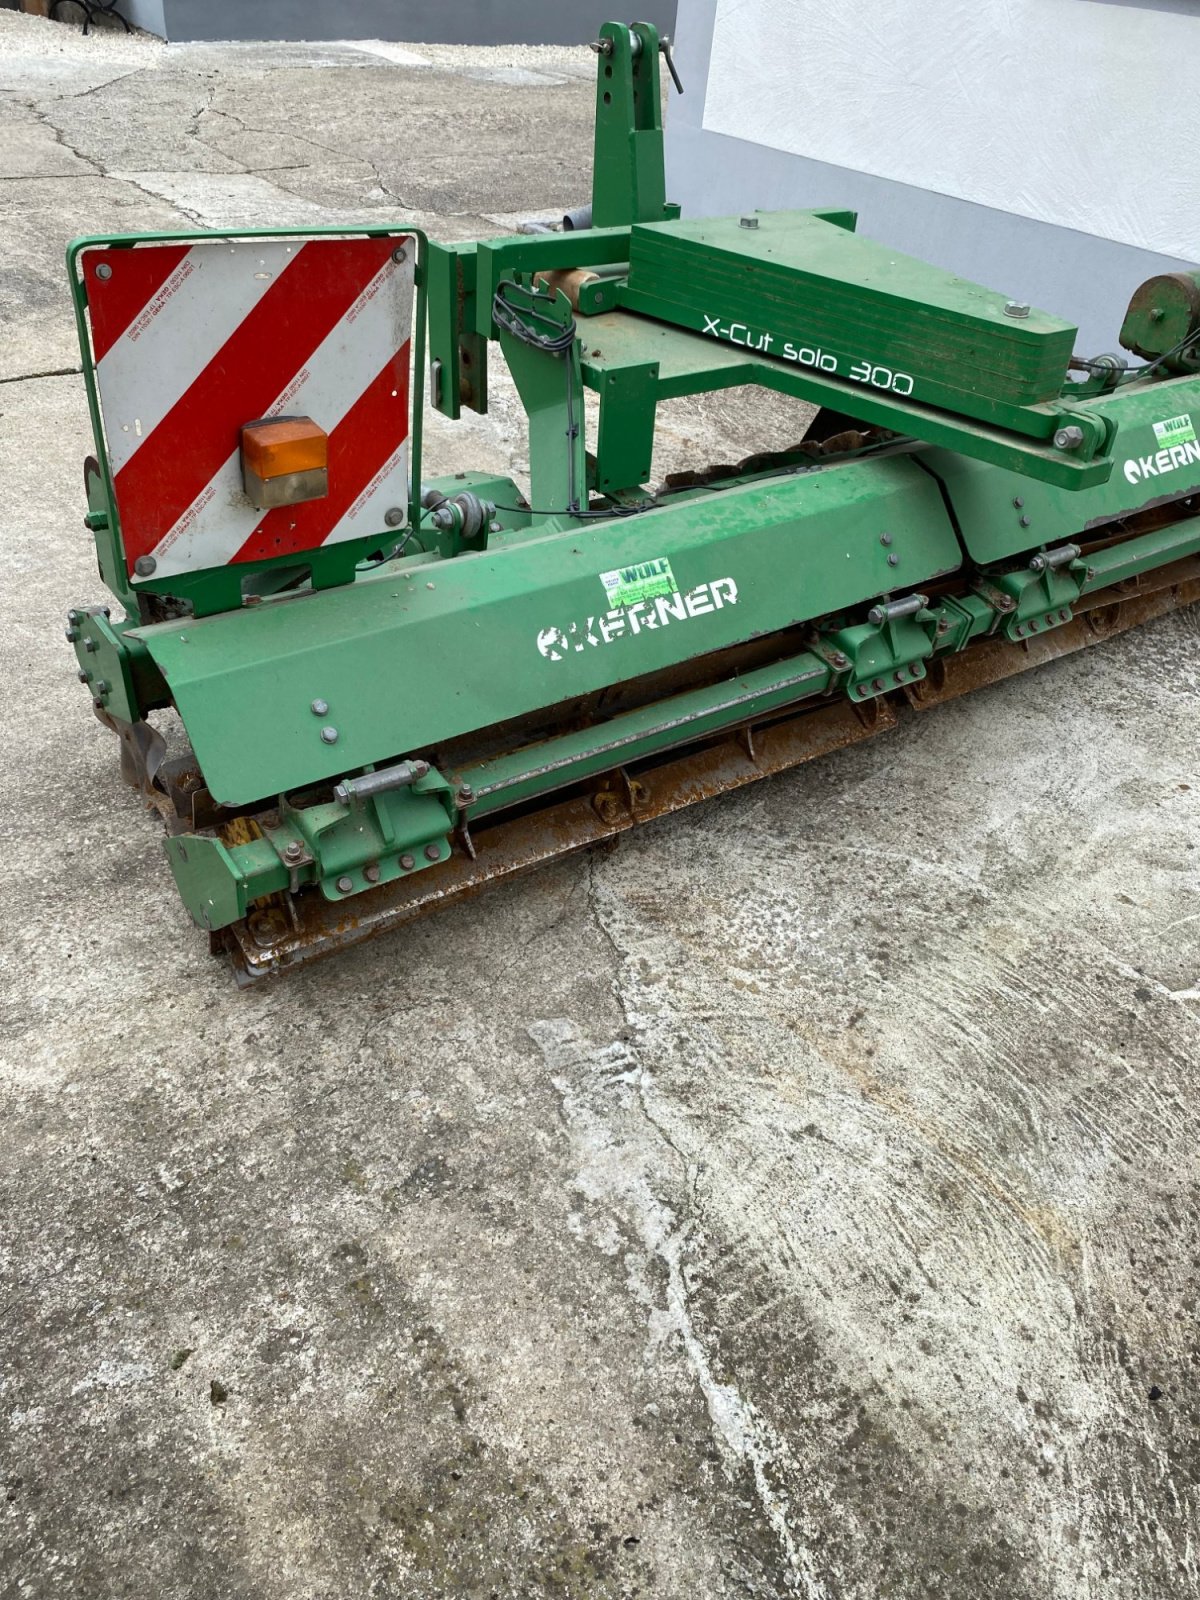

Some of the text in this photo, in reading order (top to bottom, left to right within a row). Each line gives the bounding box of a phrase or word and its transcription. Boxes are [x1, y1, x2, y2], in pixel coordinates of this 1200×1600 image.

[155, 286, 169, 302] GEKA
[152, 300, 166, 316] GEKA
[701, 314, 914, 396] X-Cut solo 300
[619, 560, 668, 583] WULF
[568, 577, 739, 652] KERNER
